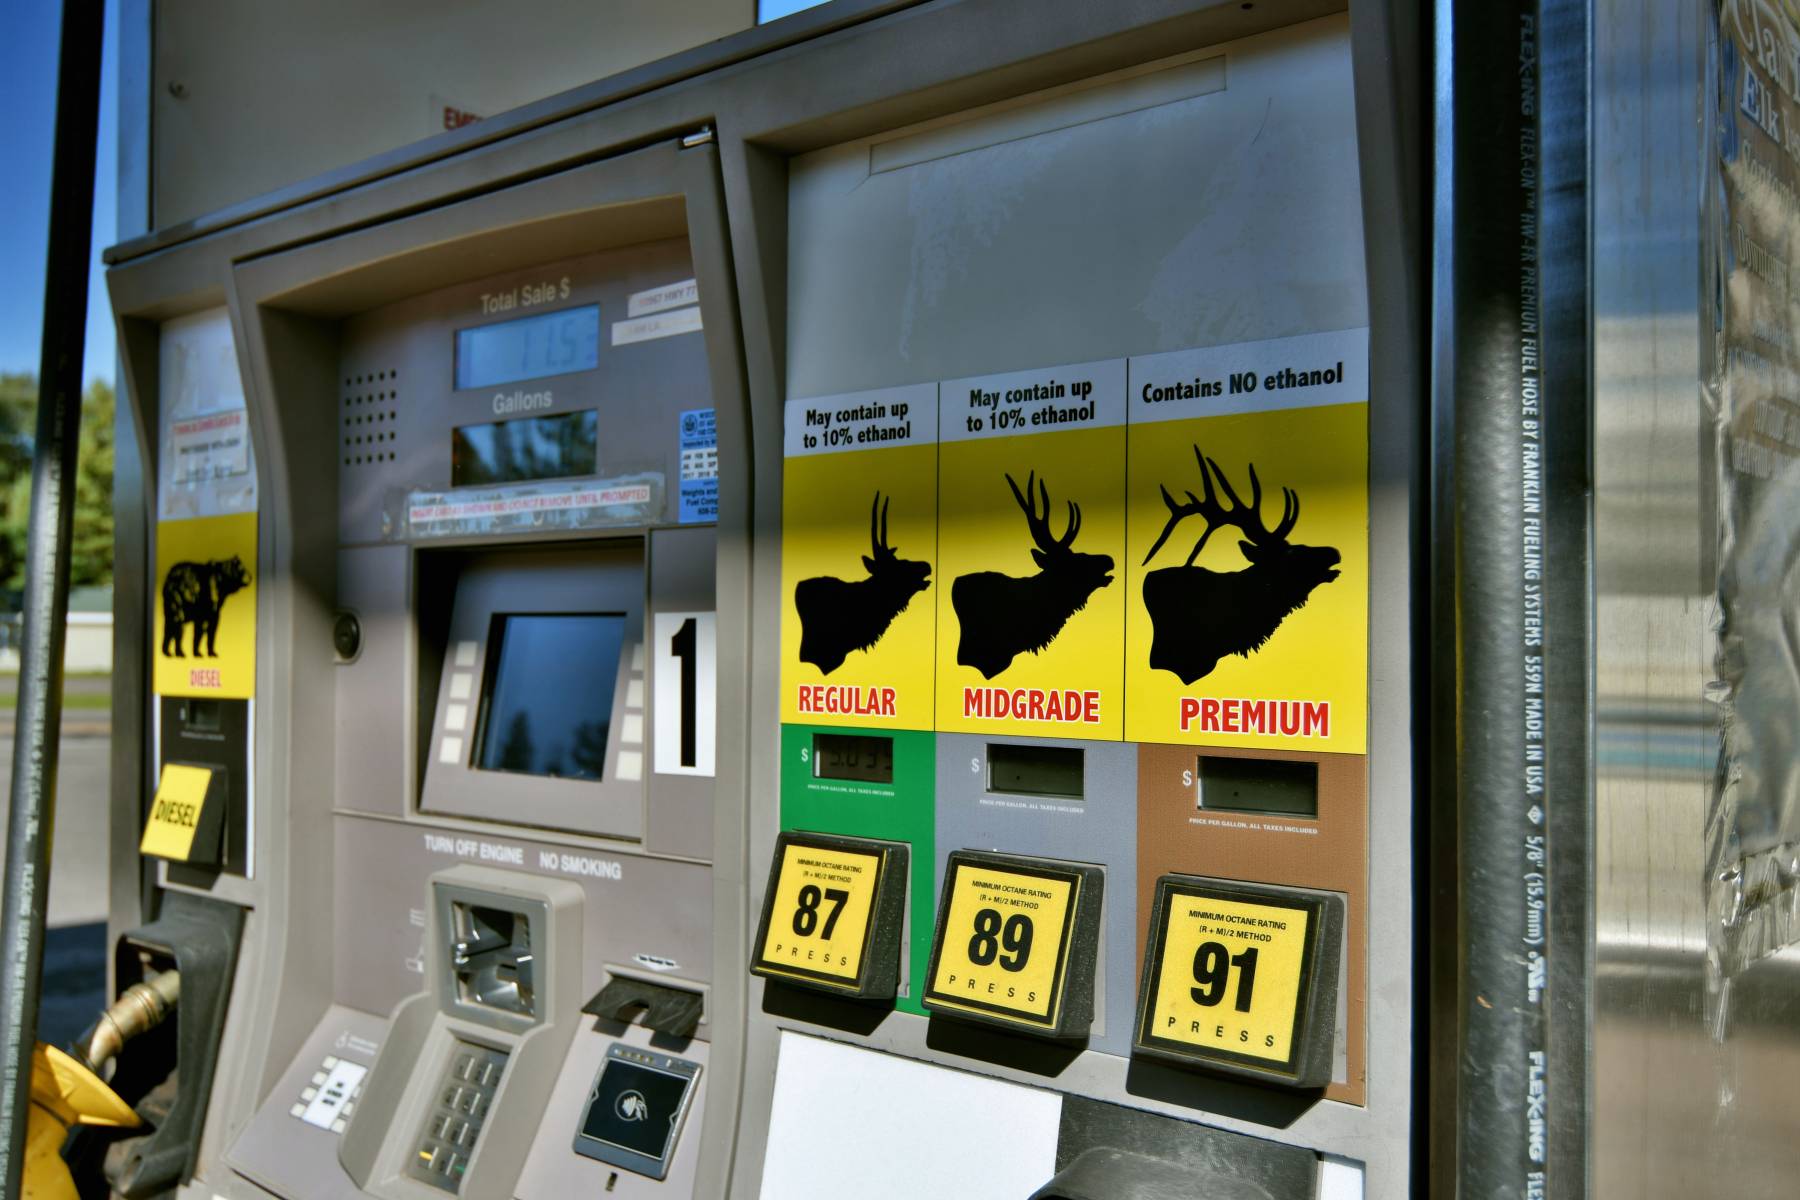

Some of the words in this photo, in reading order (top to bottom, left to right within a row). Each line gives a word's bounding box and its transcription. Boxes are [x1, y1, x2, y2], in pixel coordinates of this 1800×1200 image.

[1740, 57, 1780, 143] Elk
[480, 289, 518, 315] Total
[521, 282, 556, 307] Sale
[560, 276, 571, 300] $
[1521, 266, 1536, 333] PREMIUM
[1521, 338, 1537, 373] FUEL
[969, 388, 1000, 411] May
[1005, 380, 1065, 404] contain
[1071, 380, 1092, 401] up
[1142, 377, 1222, 404] Contains
[1229, 371, 1258, 395] NO
[1263, 361, 1344, 391] ethanol
[1522, 377, 1539, 416] HOSE
[493, 390, 553, 415] Gallons
[806, 408, 831, 429] May
[836, 401, 886, 423] contain
[891, 402, 909, 421] up
[966, 415, 983, 432] to
[989, 407, 1026, 430] 10%
[1031, 400, 1095, 426] ethanol
[803, 433, 817, 449] to
[823, 426, 853, 447] 10%
[857, 420, 911, 443] ethanol
[1522, 420, 1539, 439] BY
[1522, 443, 1541, 513] FRANKLIN
[1523, 517, 1541, 580] FUELING
[1524, 584, 1542, 646] SYSTEMS
[190, 669, 221, 688] DIESEL
[1525, 655, 1543, 693] 559N
[671, 617, 697, 767] 1
[798, 685, 896, 717] REGULAR
[963, 687, 1099, 723] MIDGRADE
[1180, 697, 1329, 738] PREMIUM
[1525, 698, 1543, 739] MADE
[801, 747, 809, 763] $
[971, 758, 980, 774] $
[1526, 745, 1543, 760] IN
[1182, 769, 1192, 788] $
[1526, 765, 1543, 794] USA
[155, 799, 196, 828] DIESEL
[1189, 817, 1207, 825] PRICE
[1263, 824, 1284, 832] TAXES
[1284, 826, 1318, 834] INCLUDED
[424, 834, 454, 852] TURN
[455, 839, 478, 857] OFF
[479, 843, 524, 865] ENGINE
[539, 850, 559, 869] NO
[561, 854, 622, 880] SMOKING
[797, 858, 821, 868] MINIMUM
[822, 861, 842, 871] OCTANE
[843, 865, 862, 874] RATING
[828, 873, 852, 883] METHOD
[972, 880, 1001, 891] MINIMUM
[1002, 885, 1028, 895] OCTANE
[1028, 889, 1052, 899] RATING
[1010, 898, 1039, 910] METHOD
[792, 884, 849, 940] 87
[1188, 910, 1225, 921] MINIMUM
[1225, 914, 1257, 926] OCTANE
[1257, 919, 1287, 930] RATING
[1523, 872, 1545, 945] (15.9mm)
[967, 908, 1034, 972] 89
[1199, 925, 1207, 933] (R
[1216, 927, 1234, 937] M)/2
[1236, 930, 1272, 942] METHOD
[1190, 941, 1259, 1013] 91
